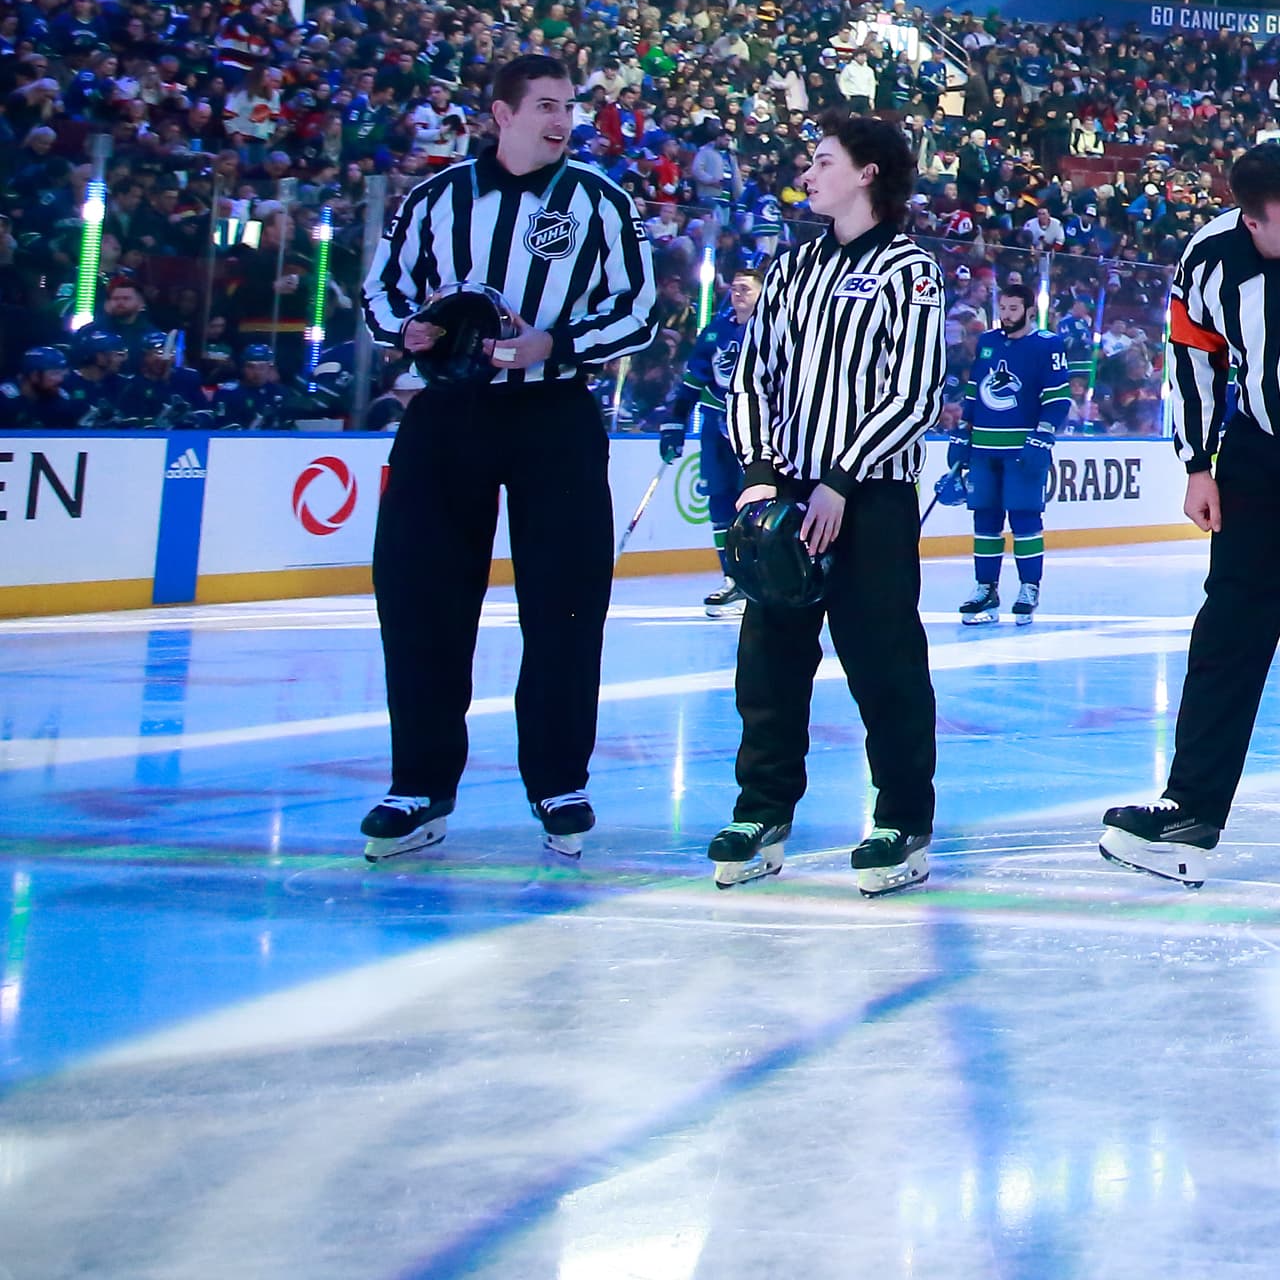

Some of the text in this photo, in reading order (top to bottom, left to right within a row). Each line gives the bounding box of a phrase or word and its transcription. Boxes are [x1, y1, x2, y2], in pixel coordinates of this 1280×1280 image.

[1151, 5, 1174, 26] GO
[1180, 8, 1259, 34] CANUCKS
[535, 223, 568, 246] NHL
[843, 278, 877, 292] BC
[1051, 352, 1068, 371] 34
[165, 466, 208, 479] adidas
